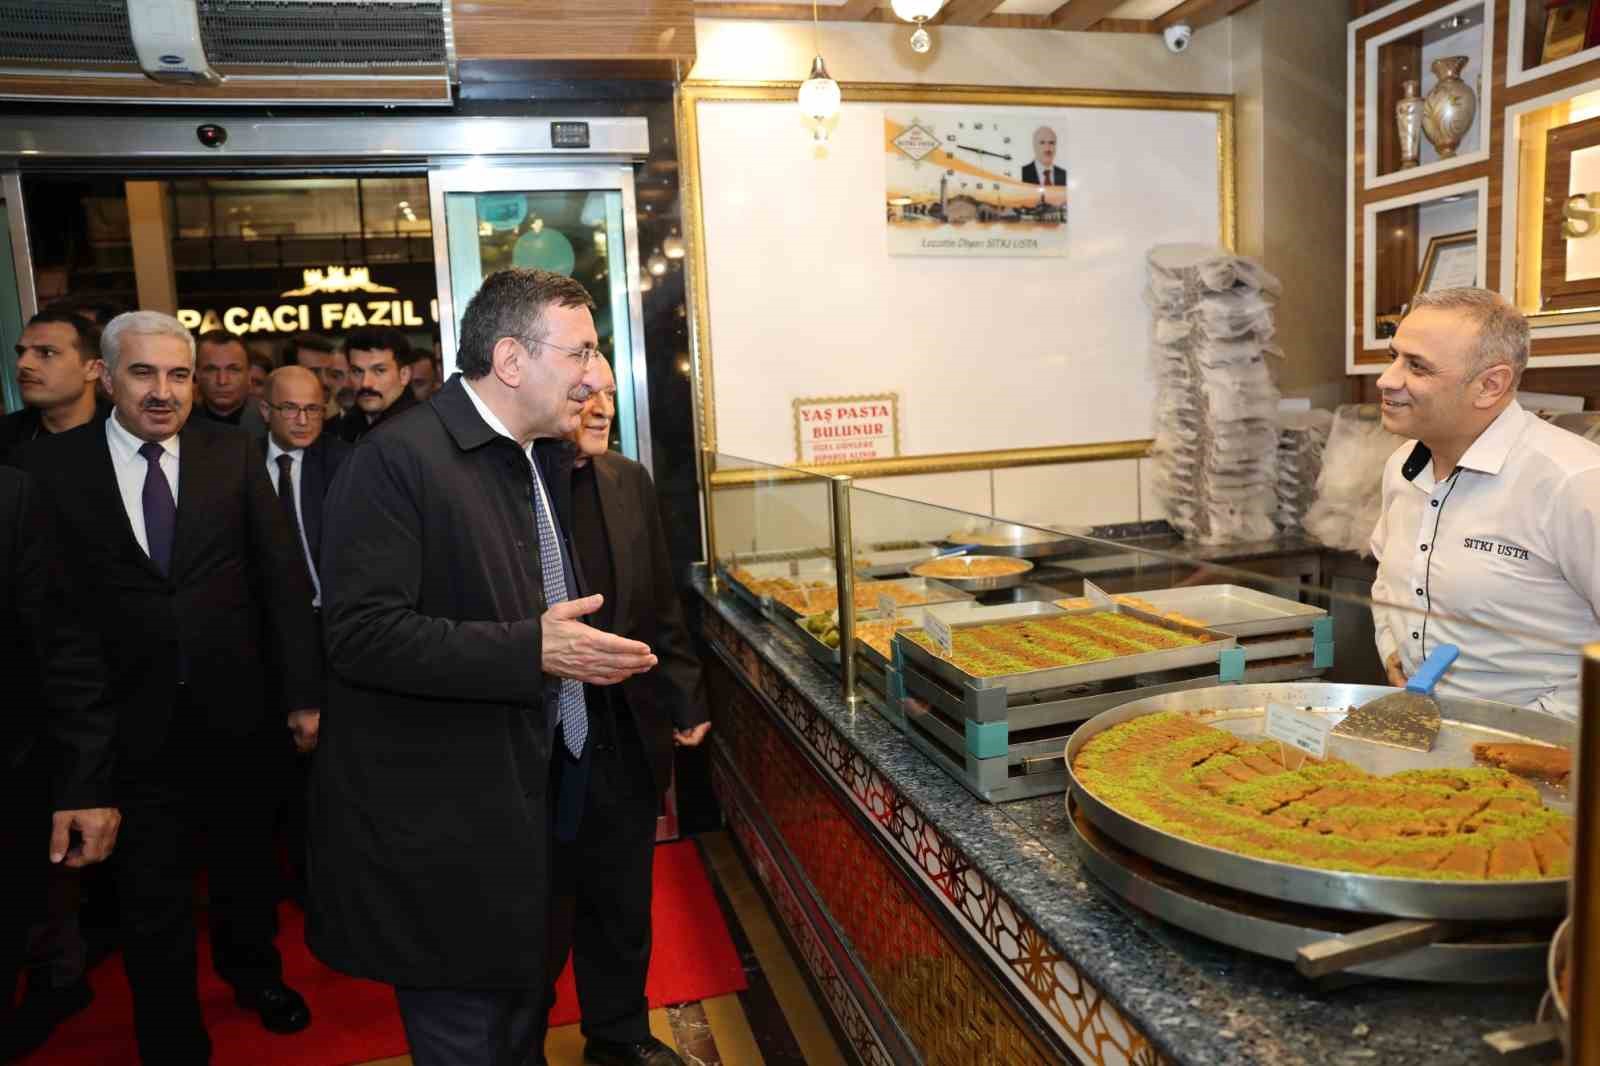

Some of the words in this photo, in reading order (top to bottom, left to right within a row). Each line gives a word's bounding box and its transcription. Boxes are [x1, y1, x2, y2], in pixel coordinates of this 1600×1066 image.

[177, 303, 309, 336] PAÇACI
[321, 299, 423, 330] FAZIL
[801, 408, 833, 423] YAŞ
[837, 405, 889, 419] PASTA
[813, 423, 884, 438] BULUNUR
[1497, 544, 1528, 560] USTA
